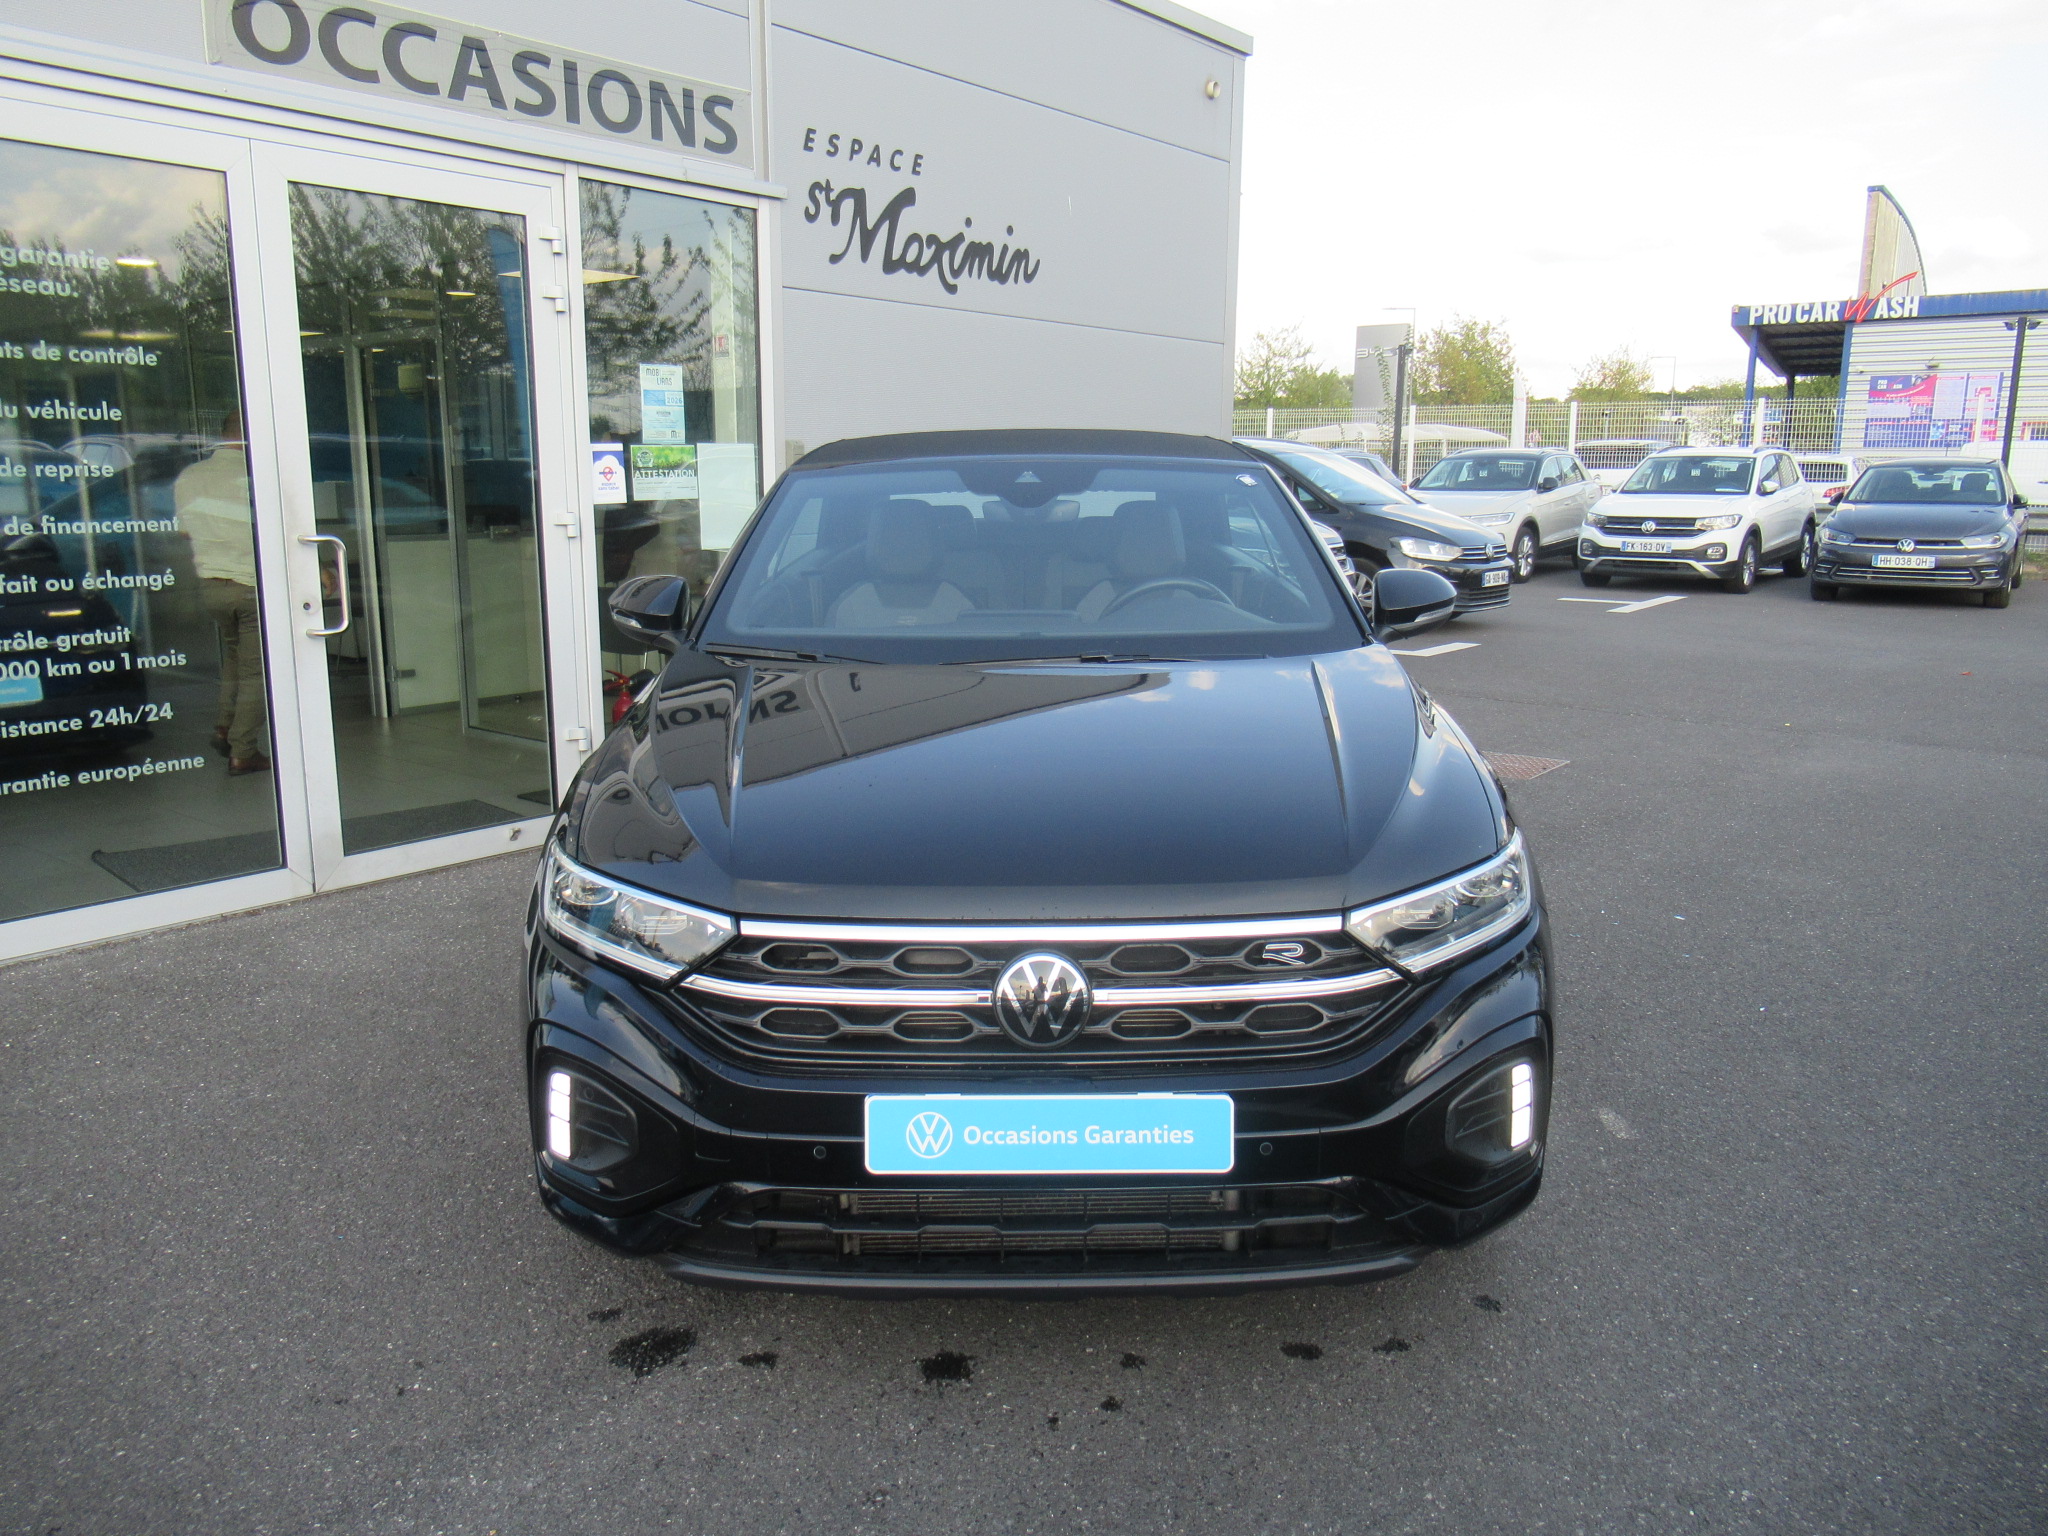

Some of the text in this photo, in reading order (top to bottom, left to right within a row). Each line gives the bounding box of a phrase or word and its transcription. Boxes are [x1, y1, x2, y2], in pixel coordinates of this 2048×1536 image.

[231, 0, 739, 155] OCCASIONS
[803, 128, 924, 176] ESPACE
[828, 187, 1041, 295] Maximin
[1, 247, 110, 271] garantie
[1749, 271, 1920, 326] PRO CAR WASH
[32, 340, 61, 362] de
[69, 346, 158, 367] contrôle
[26, 400, 123, 422] véhicule
[0, 456, 114, 481] de reprise
[634, 468, 695, 478] ATTESTATION
[4, 515, 180, 536] de financement
[0, 568, 175, 595] fait ou échangé
[57, 626, 132, 652] gratuit
[47, 658, 82, 678] km
[88, 660, 115, 674] ou
[121, 653, 131, 671] 1
[137, 649, 187, 669] mois
[89, 702, 174, 729] 24h/24
[0, 754, 205, 796] rantie européenne
[1262, 942, 1306, 966] R
[963, 1124, 1078, 1145] Occasions
[1084, 1124, 1194, 1145] Garanties
